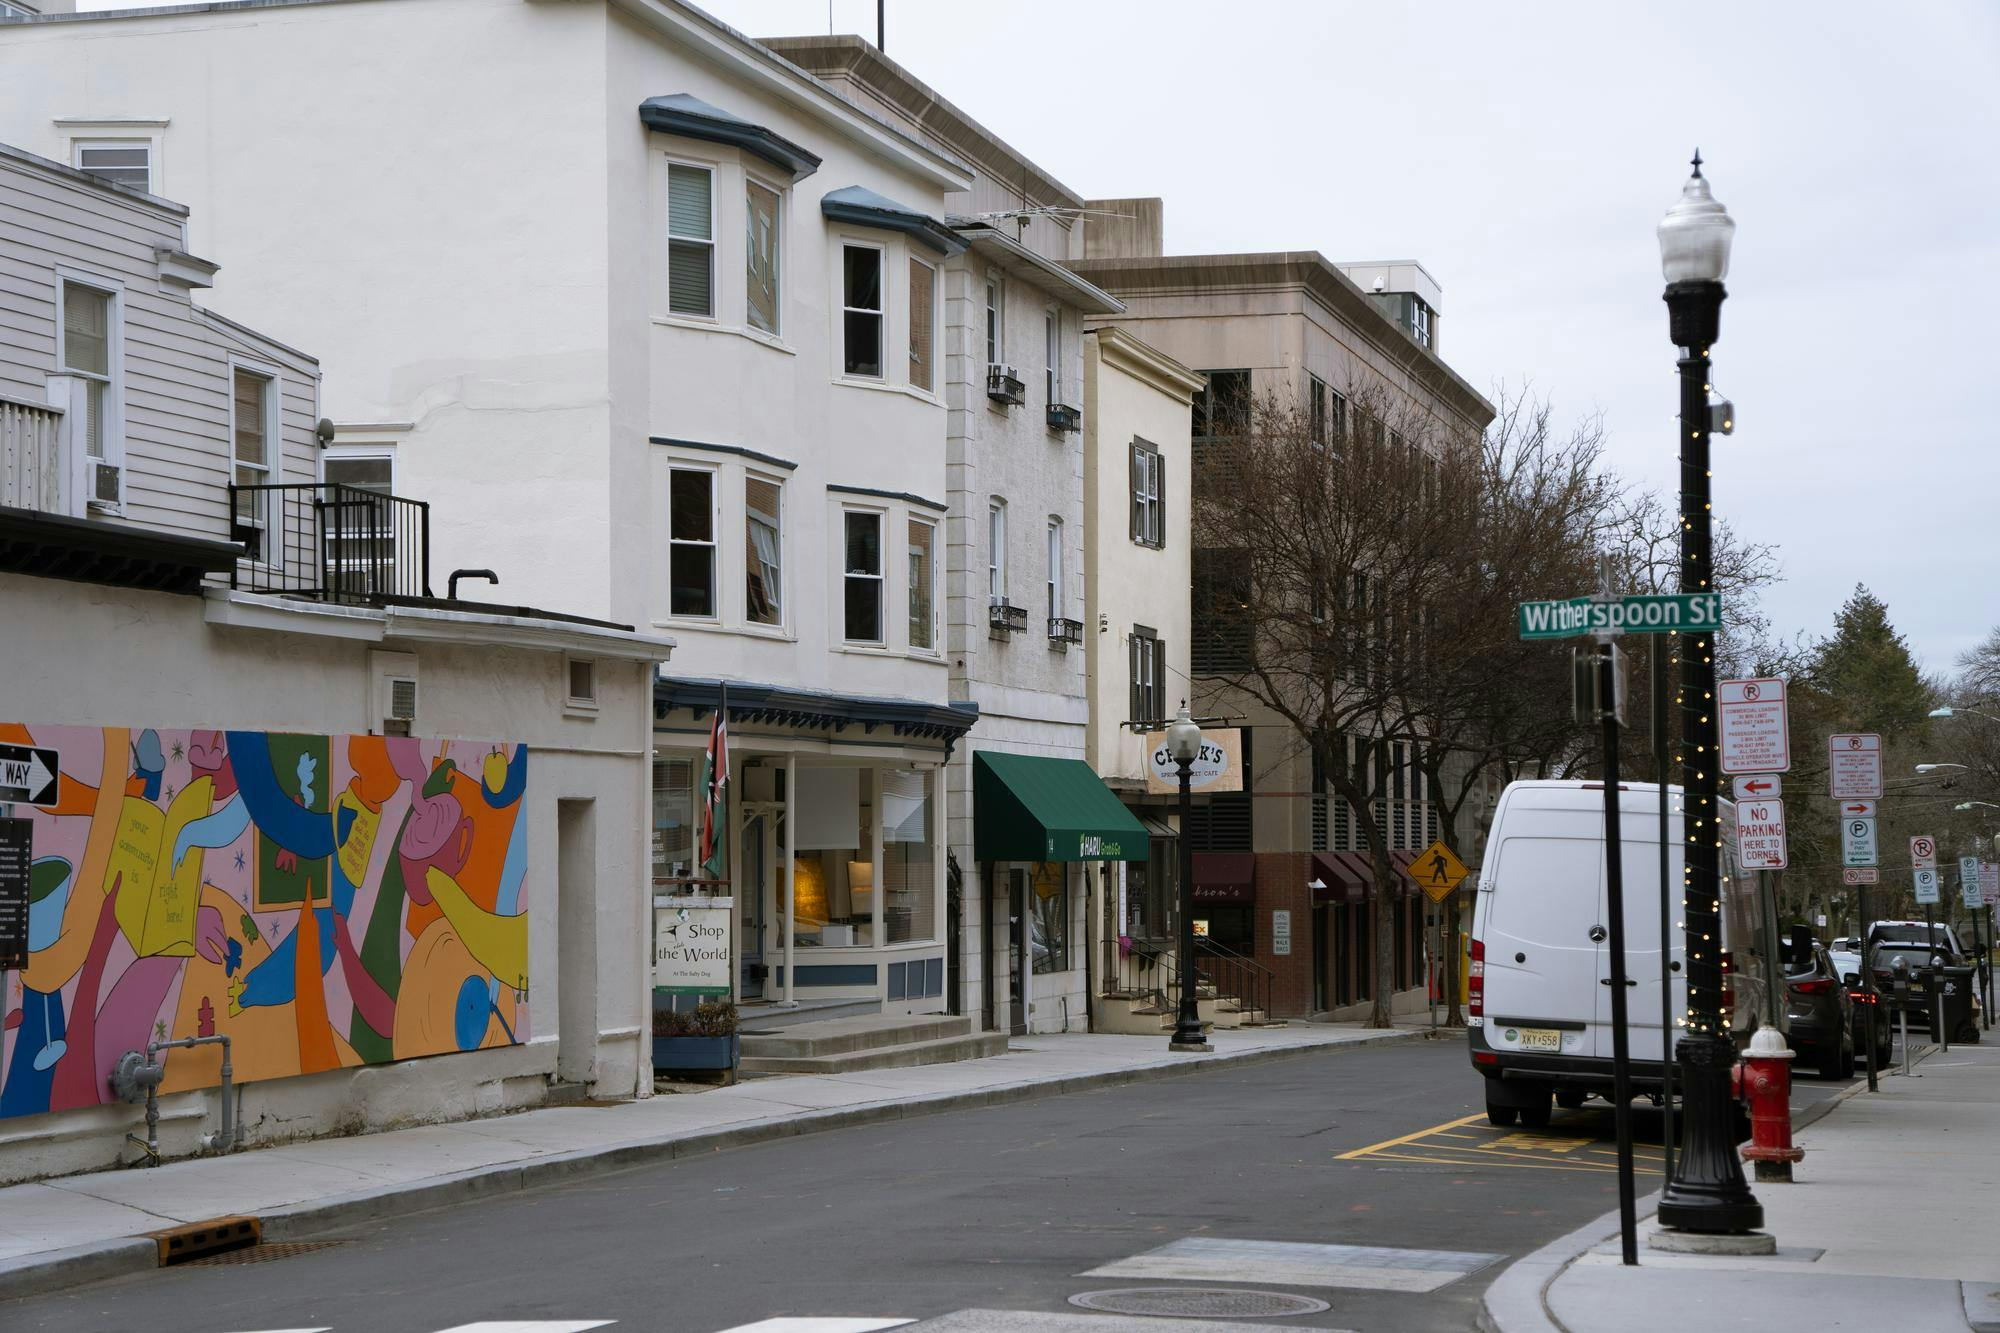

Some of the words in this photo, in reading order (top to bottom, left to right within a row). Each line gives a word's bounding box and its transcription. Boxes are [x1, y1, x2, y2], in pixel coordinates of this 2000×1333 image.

[1524, 600, 1680, 631] Witherspoon
[1689, 596, 1718, 624] St
[1155, 746, 1223, 766] CHK'S
[6, 763, 31, 786] WAY
[1751, 807, 1768, 821] NO
[129, 819, 149, 835] your
[1740, 823, 1782, 837] PARKING
[1085, 836, 1101, 856] HARU
[1744, 840, 1766, 849] HERE
[1770, 840, 1780, 848] TO
[119, 839, 154, 871] community
[1746, 850, 1779, 860] CORNER
[131, 869, 138, 883] is
[160, 882, 178, 905] right
[166, 906, 184, 923] here!
[689, 924, 724, 940] Shop
[659, 948, 678, 960] the
[684, 948, 727, 962] World
